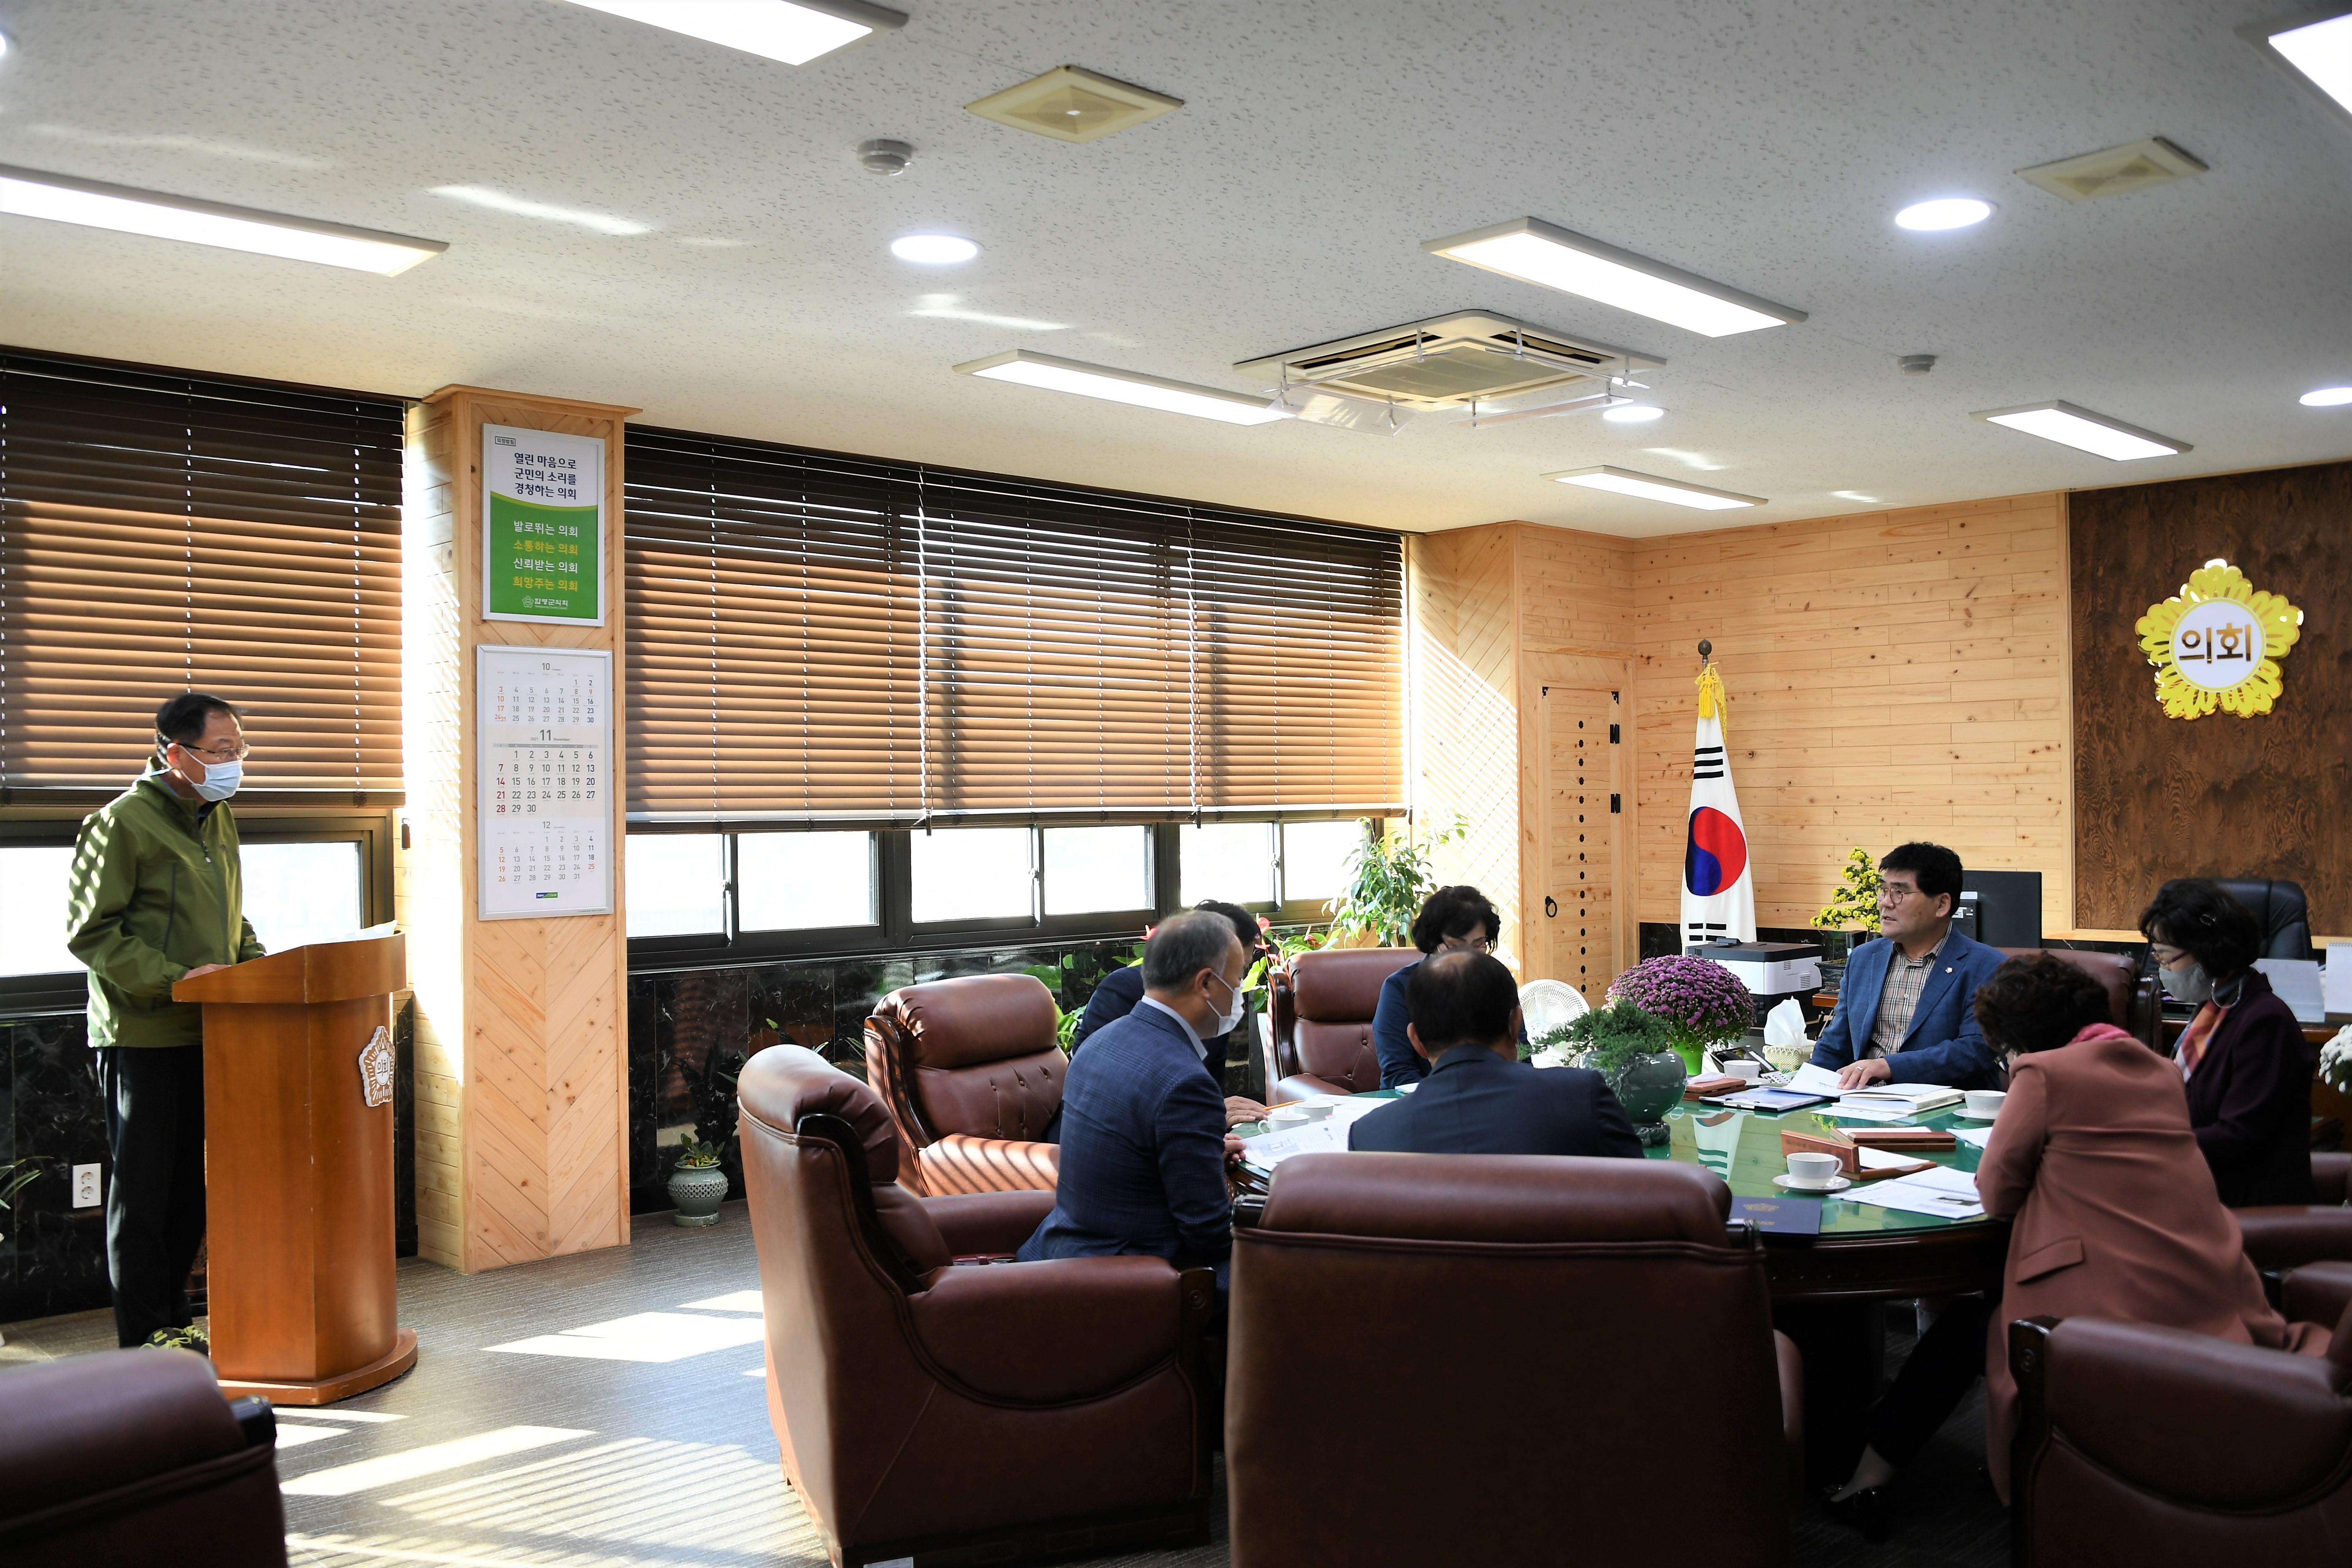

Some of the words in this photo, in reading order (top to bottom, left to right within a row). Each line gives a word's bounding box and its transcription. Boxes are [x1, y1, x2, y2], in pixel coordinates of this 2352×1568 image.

[514, 452, 534, 466] 열린
[537, 455, 577, 470] 마음으로
[514, 468, 544, 482] 군민의
[547, 471, 577, 485] 소리를
[514, 483, 554, 498] 경청하는
[558, 488, 577, 500] 의회
[514, 521, 555, 535] 발로뛰는
[558, 525, 578, 538] 의회
[514, 540, 555, 553] 소통하는
[558, 543, 578, 555] 의회
[514, 558, 555, 572] 신뢰받는
[558, 562, 578, 574] 의회
[513, 577, 554, 590] 희망주는
[558, 580, 578, 591] 의회
[535, 598, 568, 606] 함평군의회
[2179, 623, 2251, 664] 의회
[540, 730, 551, 740] 11
[377, 1057, 389, 1077] 의회
